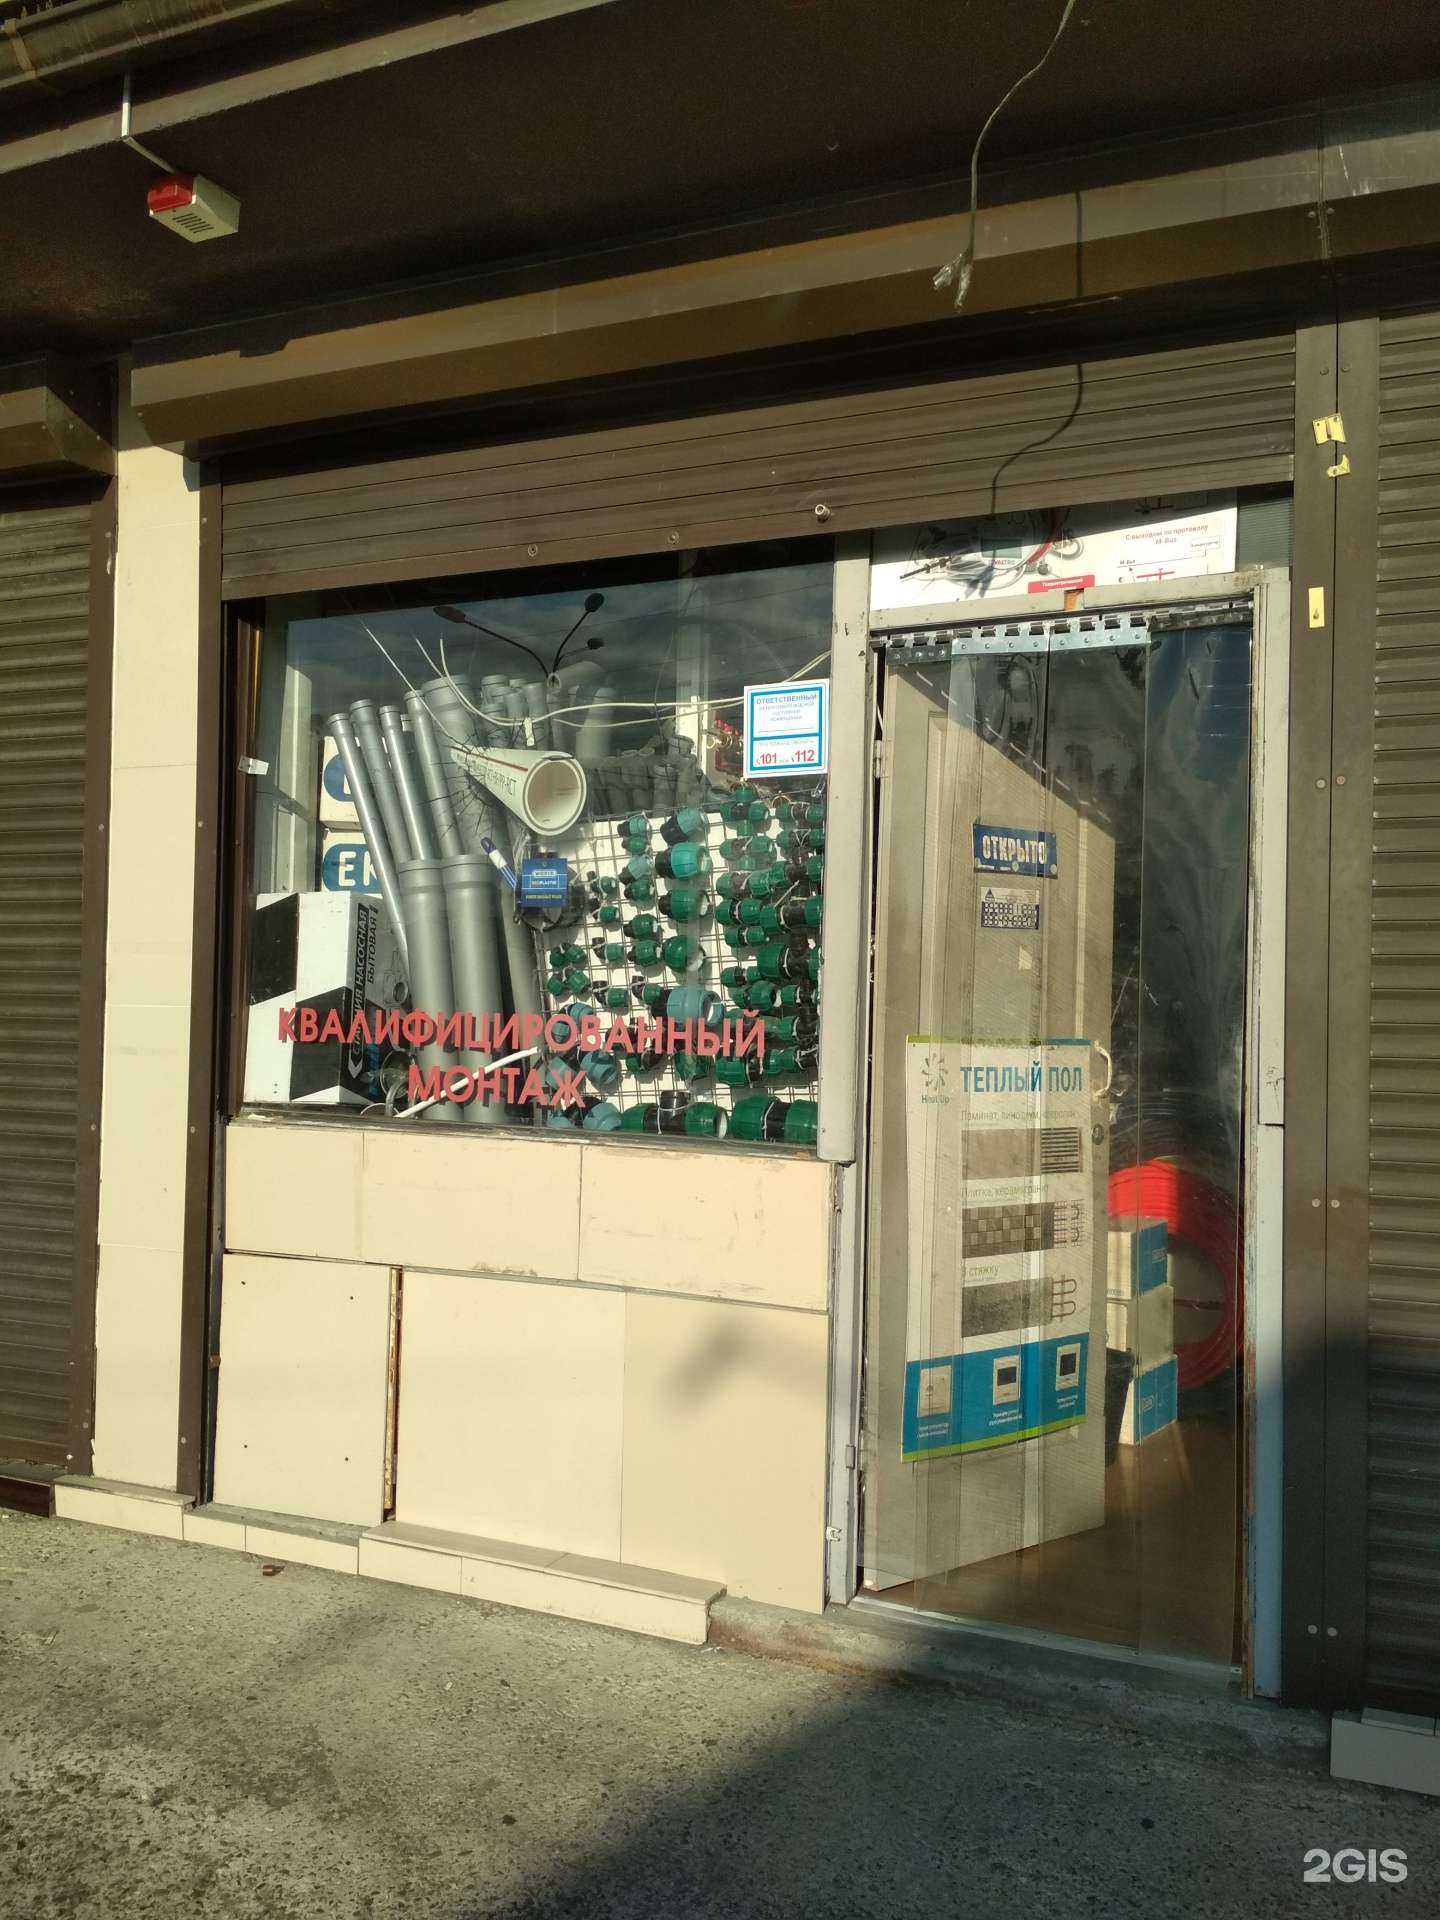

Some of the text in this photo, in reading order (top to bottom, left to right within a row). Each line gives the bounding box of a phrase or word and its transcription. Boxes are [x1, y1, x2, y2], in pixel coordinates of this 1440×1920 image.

[760, 749, 815, 765] 101 112
[982, 834, 1047, 865] ОТКРЫТО
[355, 911, 368, 987] НАСОСНАЯ
[367, 917, 377, 985] БЫТОВАЯ
[278, 1007, 766, 1058] КВАЛИФИЦИРОВАННЫЙ
[408, 1064, 587, 1109] МОНТАЖ
[960, 1060, 1083, 1093] ТЕПЛЫЙ ПОЛ
